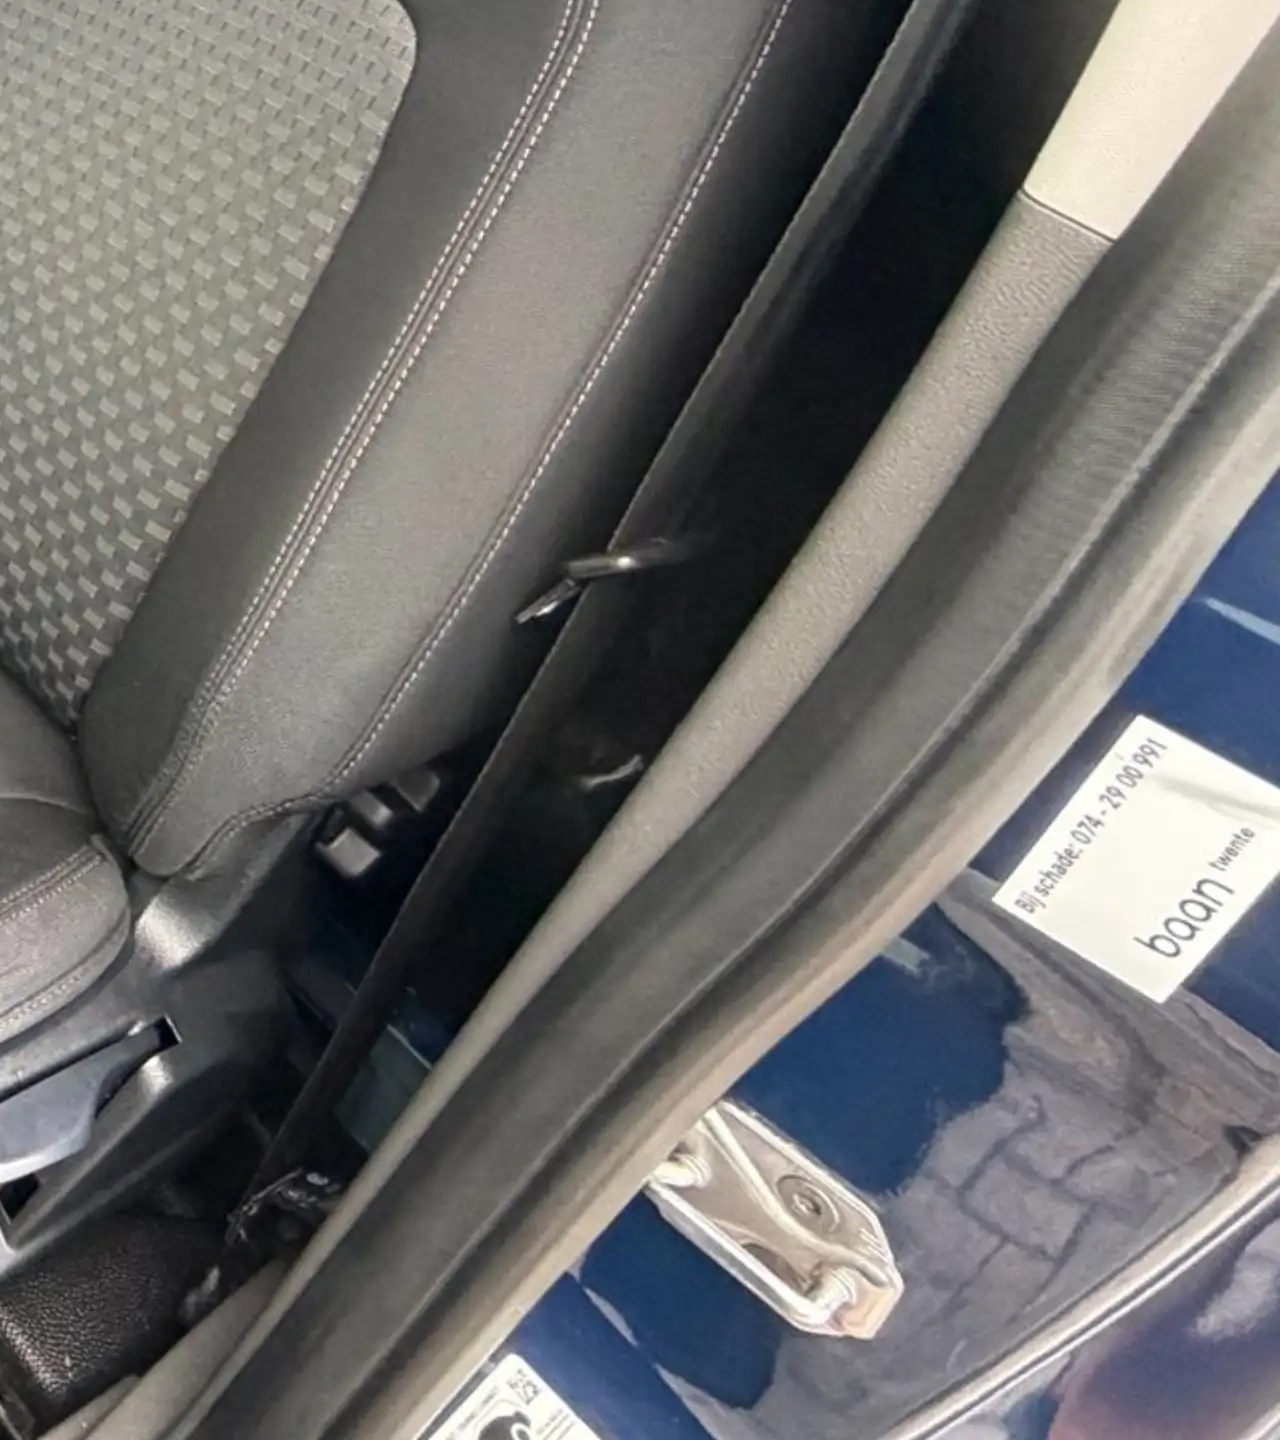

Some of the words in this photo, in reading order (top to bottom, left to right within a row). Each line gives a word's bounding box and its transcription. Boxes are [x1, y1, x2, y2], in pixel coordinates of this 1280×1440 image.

[1013, 890, 1048, 914] Bij
[1033, 842, 1085, 898] schade:
[1070, 814, 1106, 846] 074
[1098, 785, 1129, 811] 29
[1115, 764, 1145, 789] 00
[1131, 737, 1169, 769] 991
[1132, 877, 1235, 959] baan
[1207, 827, 1256, 872] twente
